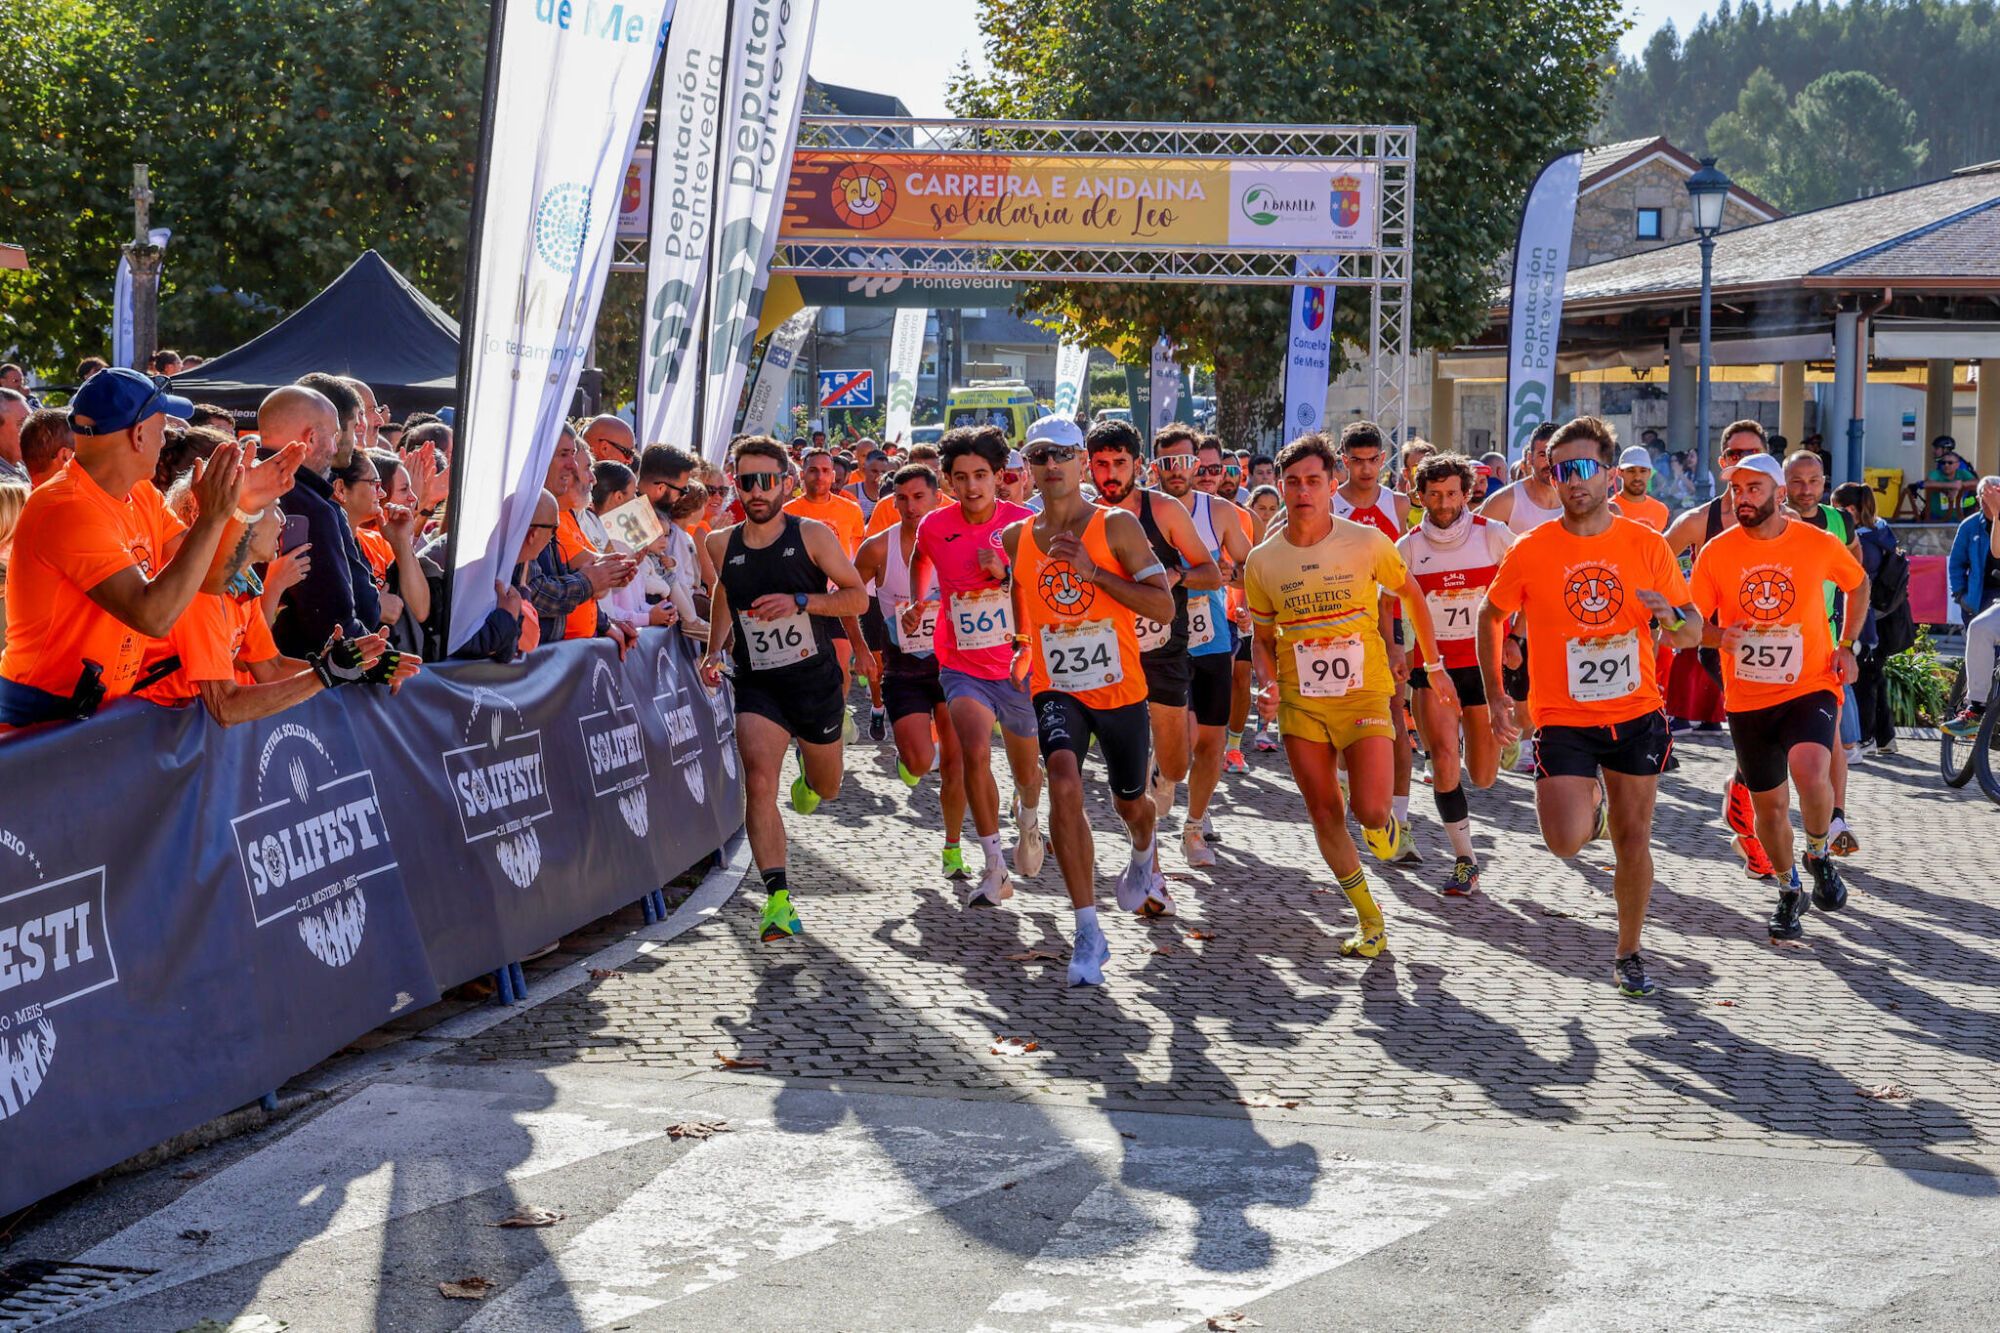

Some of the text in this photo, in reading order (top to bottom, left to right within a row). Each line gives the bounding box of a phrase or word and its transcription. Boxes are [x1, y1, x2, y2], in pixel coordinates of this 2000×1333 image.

[665, 48, 701, 257] Deputación
[685, 54, 724, 261] Pontevedra
[905, 172, 1206, 200] CARREIRA E ANDAINA
[930, 187, 1179, 237] solidaria de Leo
[1522, 247, 1543, 368] Deputación
[1537, 249, 1557, 369] Pontevedra
[749, 378, 767, 420] DEPORTE
[756, 385, 772, 421] GALEGO
[1283, 588, 1352, 610] ATHLETICS
[1294, 602, 1342, 615] San Lázaro
[960, 608, 1008, 635] 561
[1444, 607, 1470, 627] 71
[752, 625, 803, 653] 316
[1050, 643, 1111, 675] 234
[1312, 657, 1350, 682] 90
[1579, 654, 1631, 684] 291
[1741, 644, 1793, 667] 257
[259, 723, 325, 777] FESTIVAL SOLIDARIO
[457, 753, 543, 817] SOLIFESTI
[16, 1002, 43, 1026] MEIS
